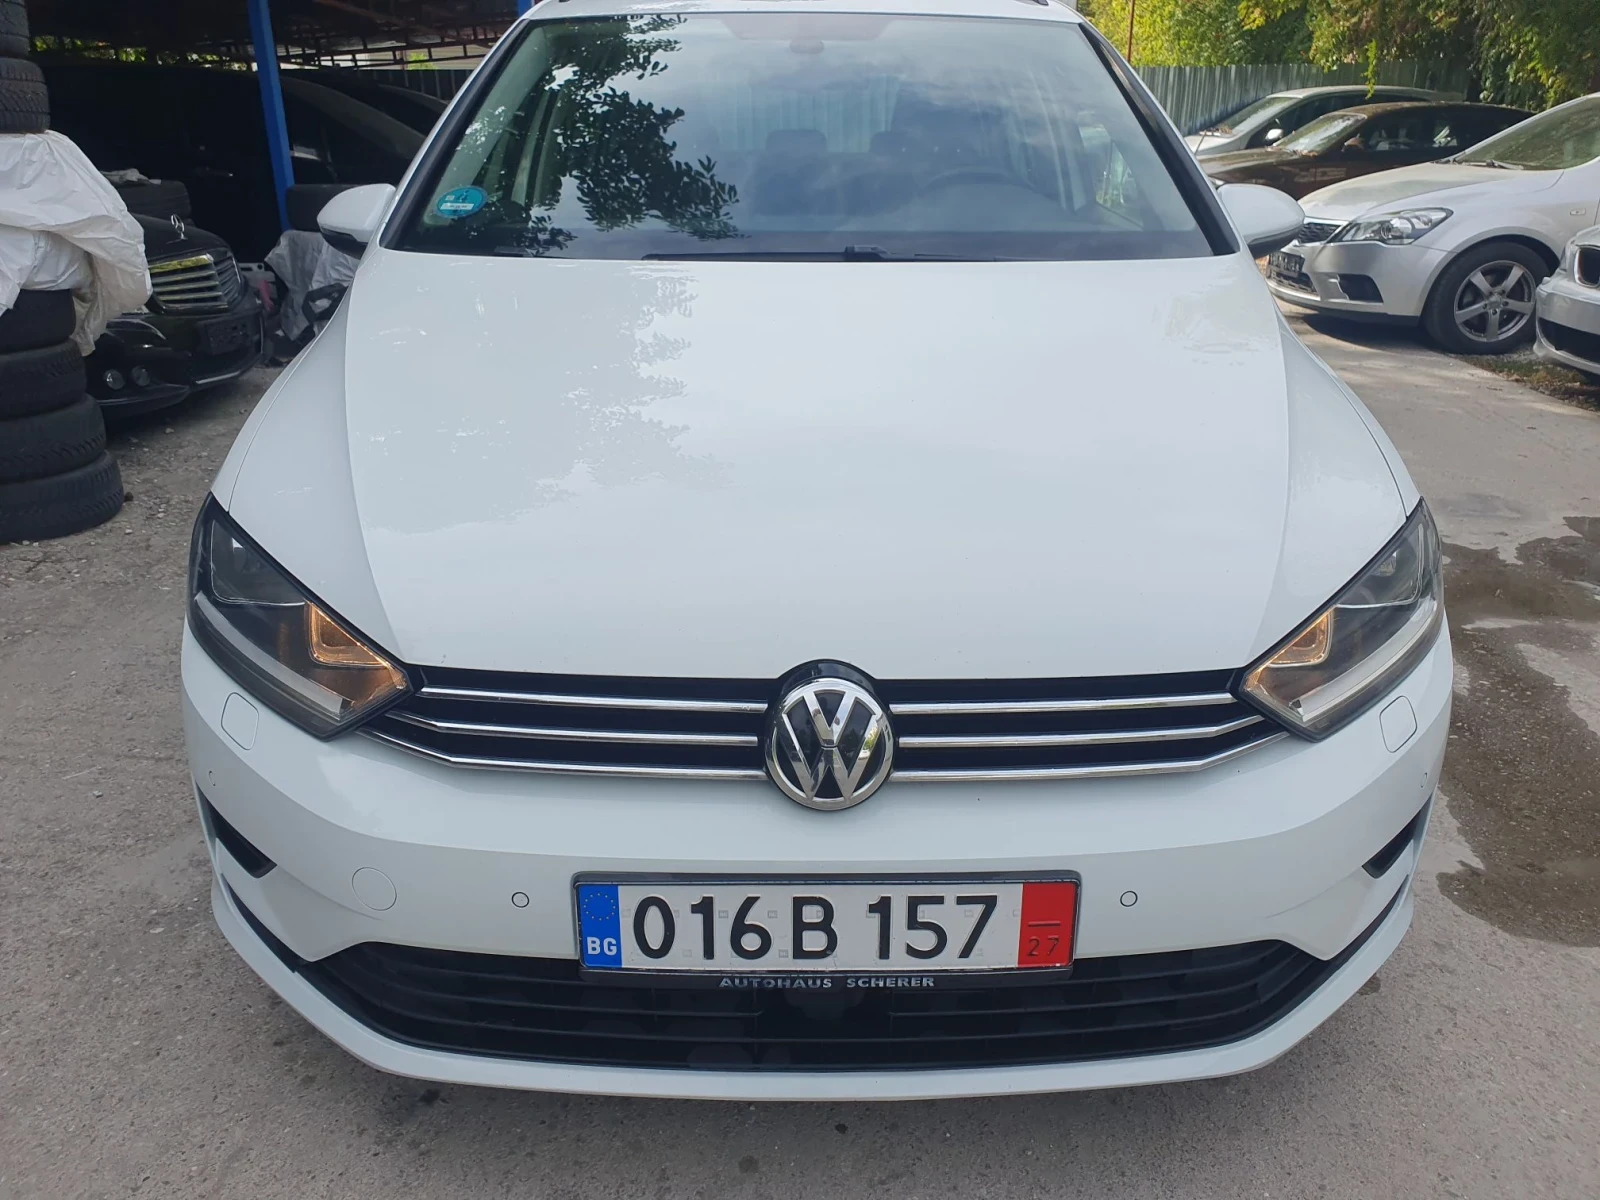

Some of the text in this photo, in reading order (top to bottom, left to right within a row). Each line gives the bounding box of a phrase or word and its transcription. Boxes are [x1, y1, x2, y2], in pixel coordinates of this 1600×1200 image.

[775, 682, 886, 805] VW
[633, 895, 998, 960] 016 B 157
[586, 936, 617, 955] BG
[1027, 935, 1060, 957] 27
[719, 977, 935, 988] AUTOHAUS SCHERER
